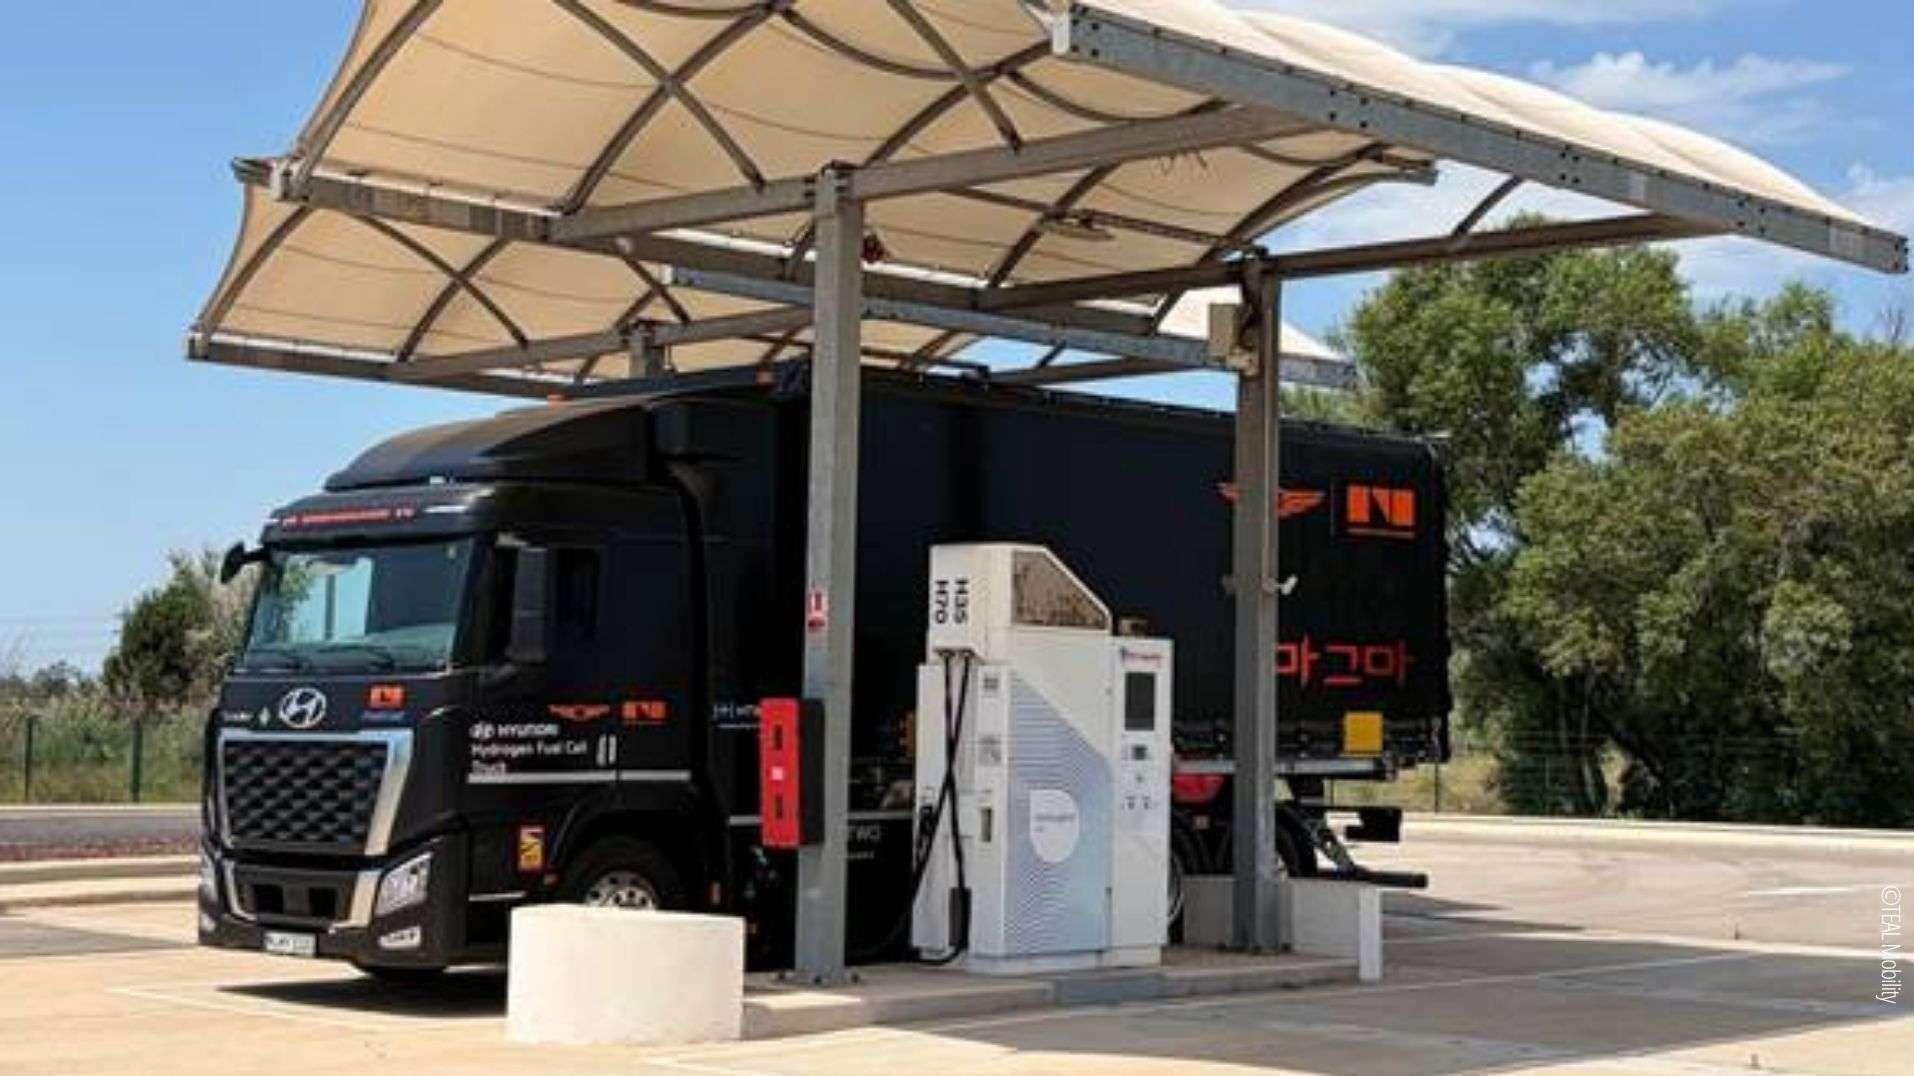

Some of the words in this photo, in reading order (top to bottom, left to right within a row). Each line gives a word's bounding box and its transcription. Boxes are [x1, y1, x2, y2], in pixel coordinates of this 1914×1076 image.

[934, 580, 949, 624] H70
[954, 579, 969, 624] H35
[497, 723, 560, 737] HYUNDAI
[471, 741, 534, 758] Hydrogen
[537, 739, 562, 755] Fuel
[566, 740, 588, 755] Cell
